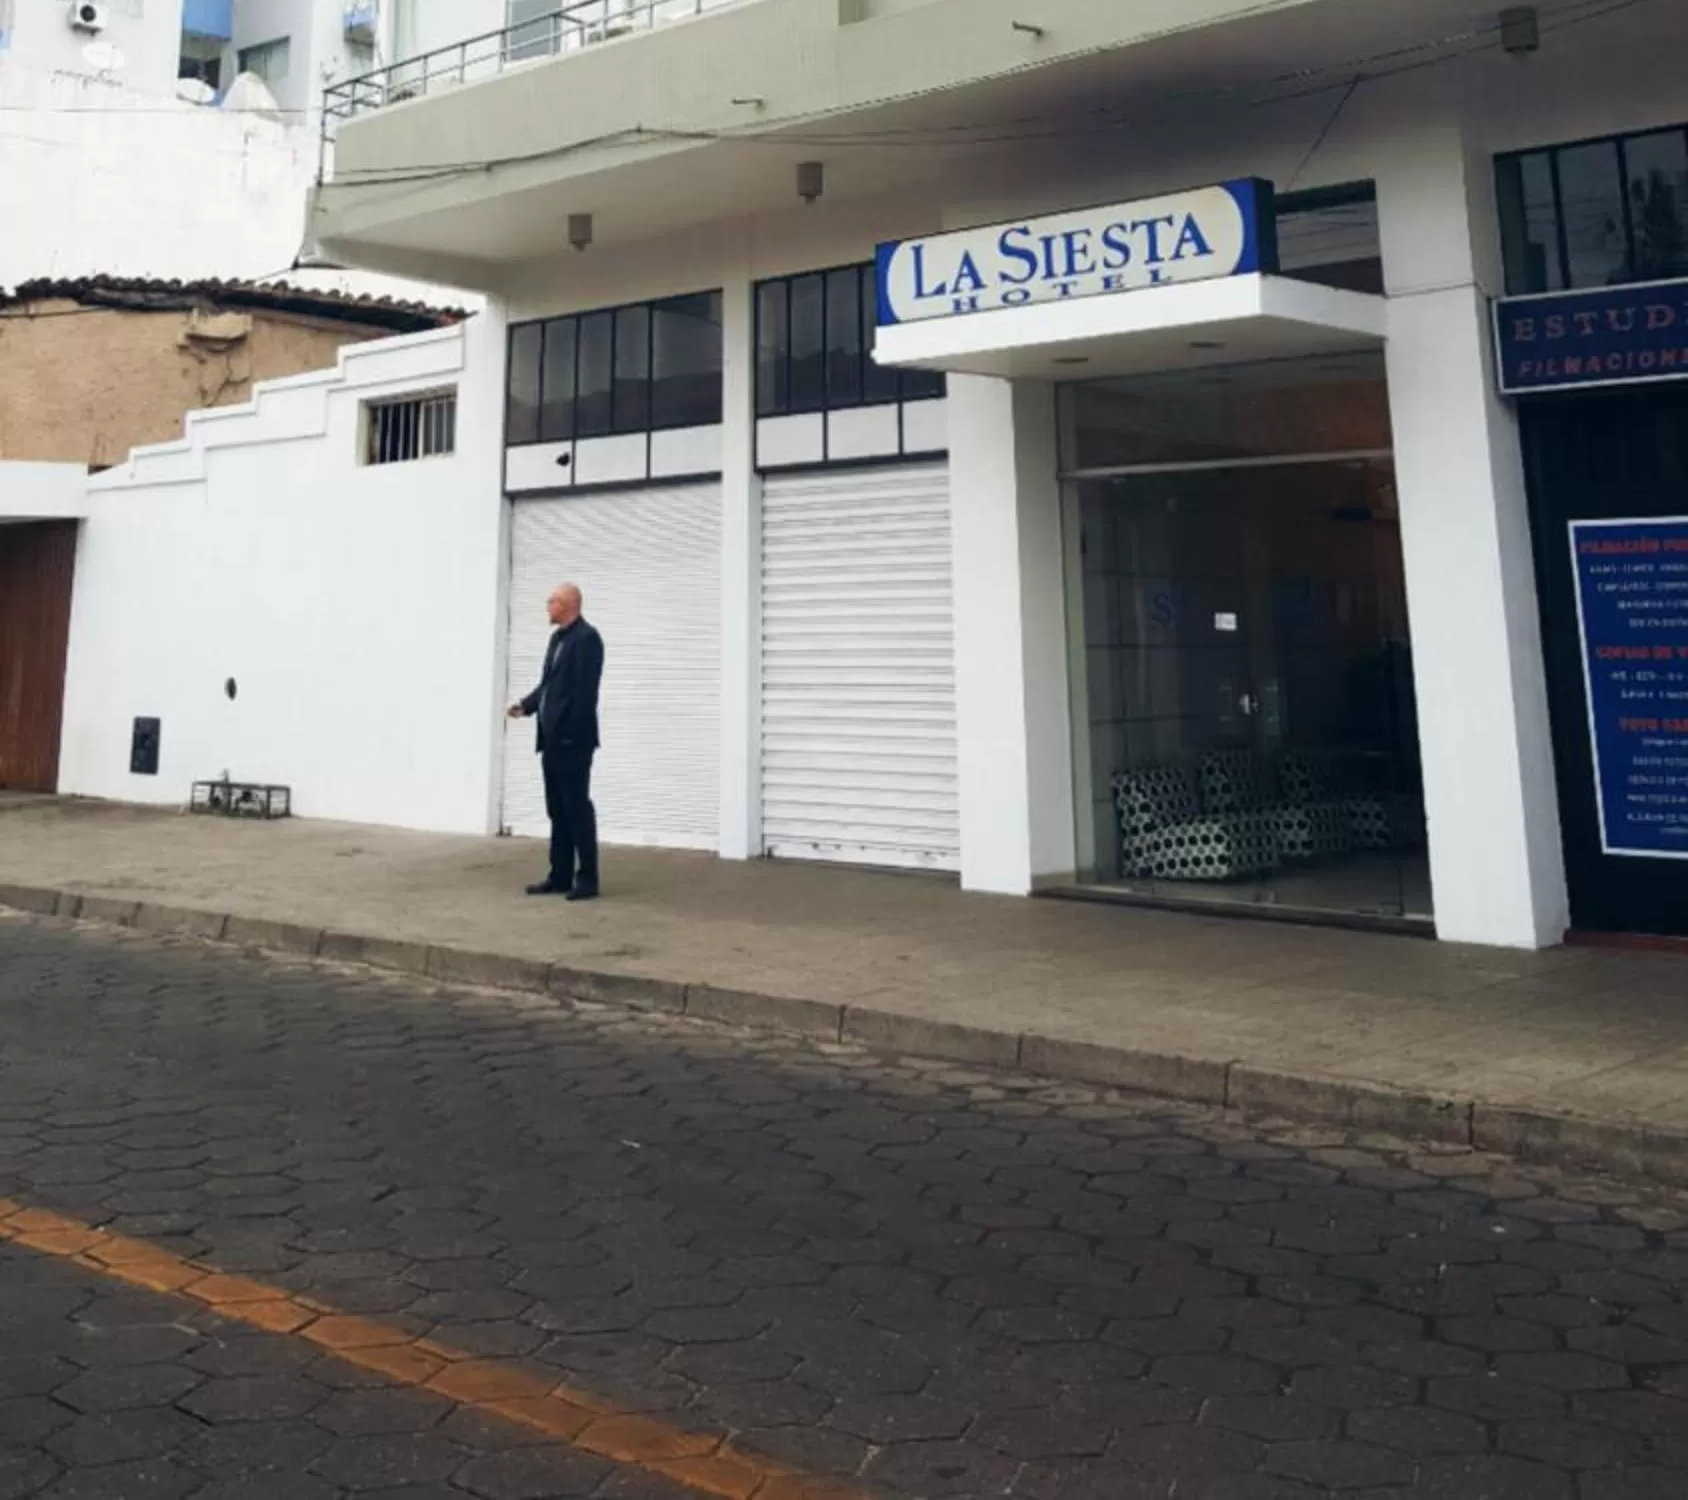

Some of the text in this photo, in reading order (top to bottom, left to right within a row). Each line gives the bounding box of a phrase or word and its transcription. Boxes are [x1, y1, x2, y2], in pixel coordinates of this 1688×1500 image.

[911, 211, 1214, 300] LA SIESTA
[951, 266, 1174, 314] HOTEL
[1512, 300, 1688, 342] ESTUD
